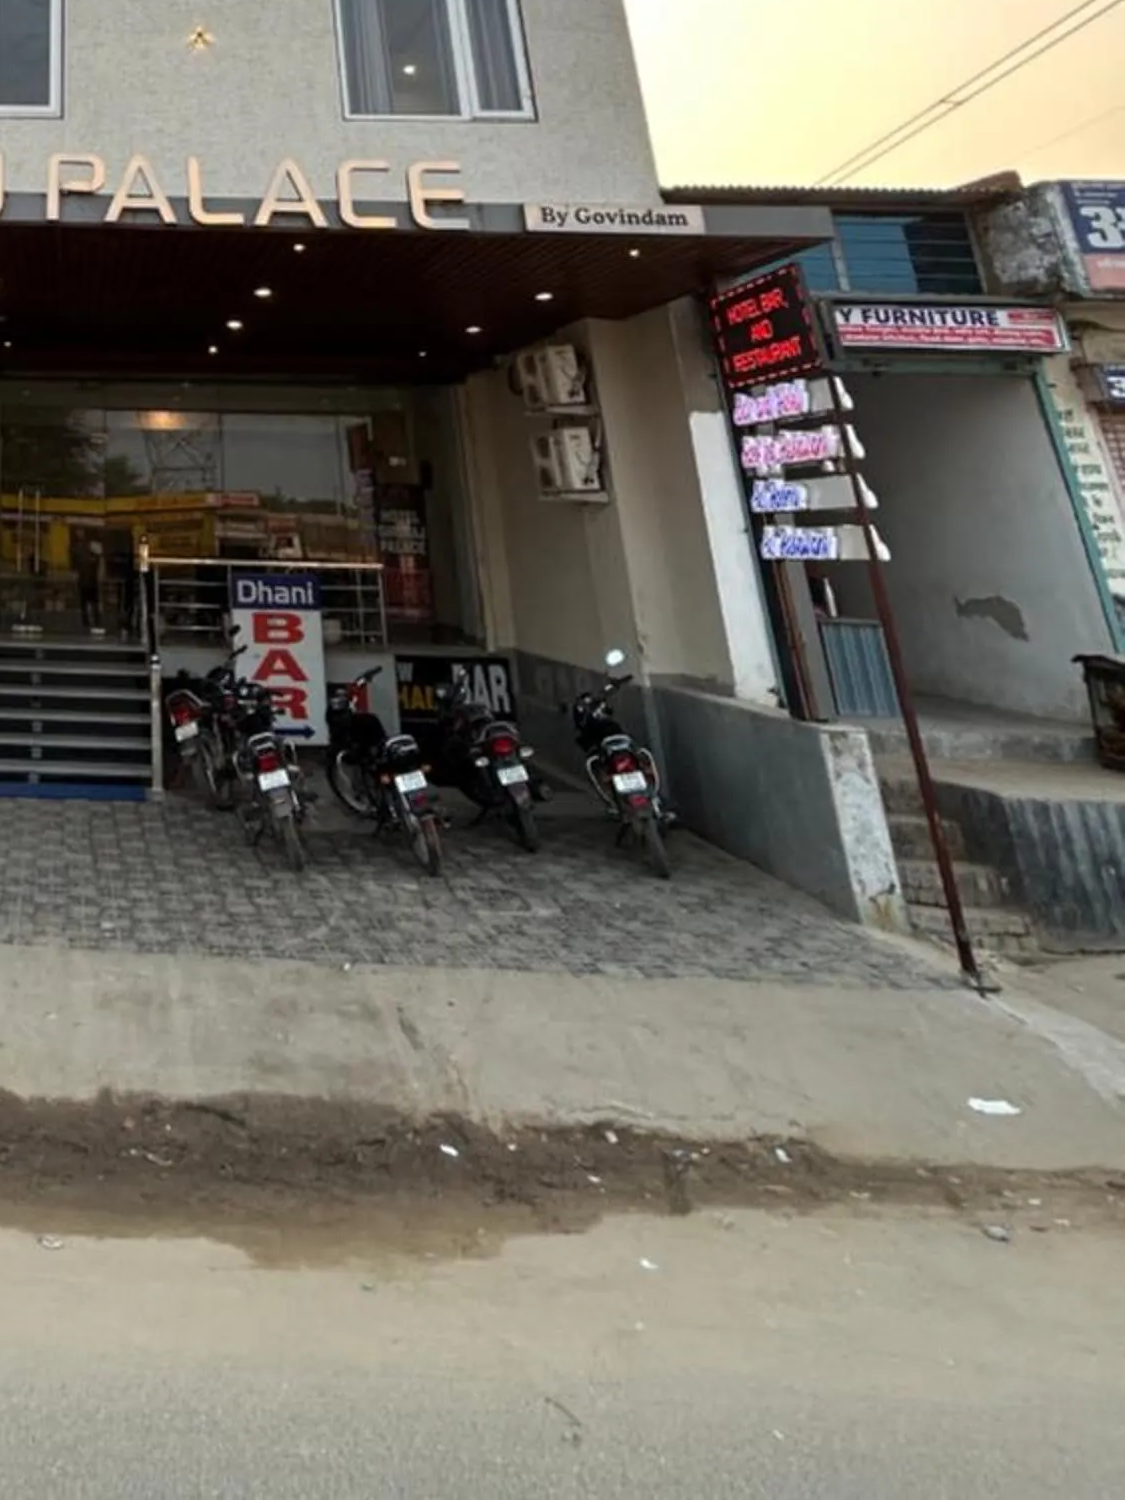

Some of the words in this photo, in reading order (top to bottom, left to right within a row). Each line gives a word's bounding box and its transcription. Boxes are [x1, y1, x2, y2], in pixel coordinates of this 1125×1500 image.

[45, 152, 471, 229] PALACE
[540, 206, 568, 227] By
[575, 206, 689, 227] Govindam
[862, 308, 1001, 326] FURNITURE
[236, 579, 315, 605] Dhani
[251, 612, 310, 721] BAR
